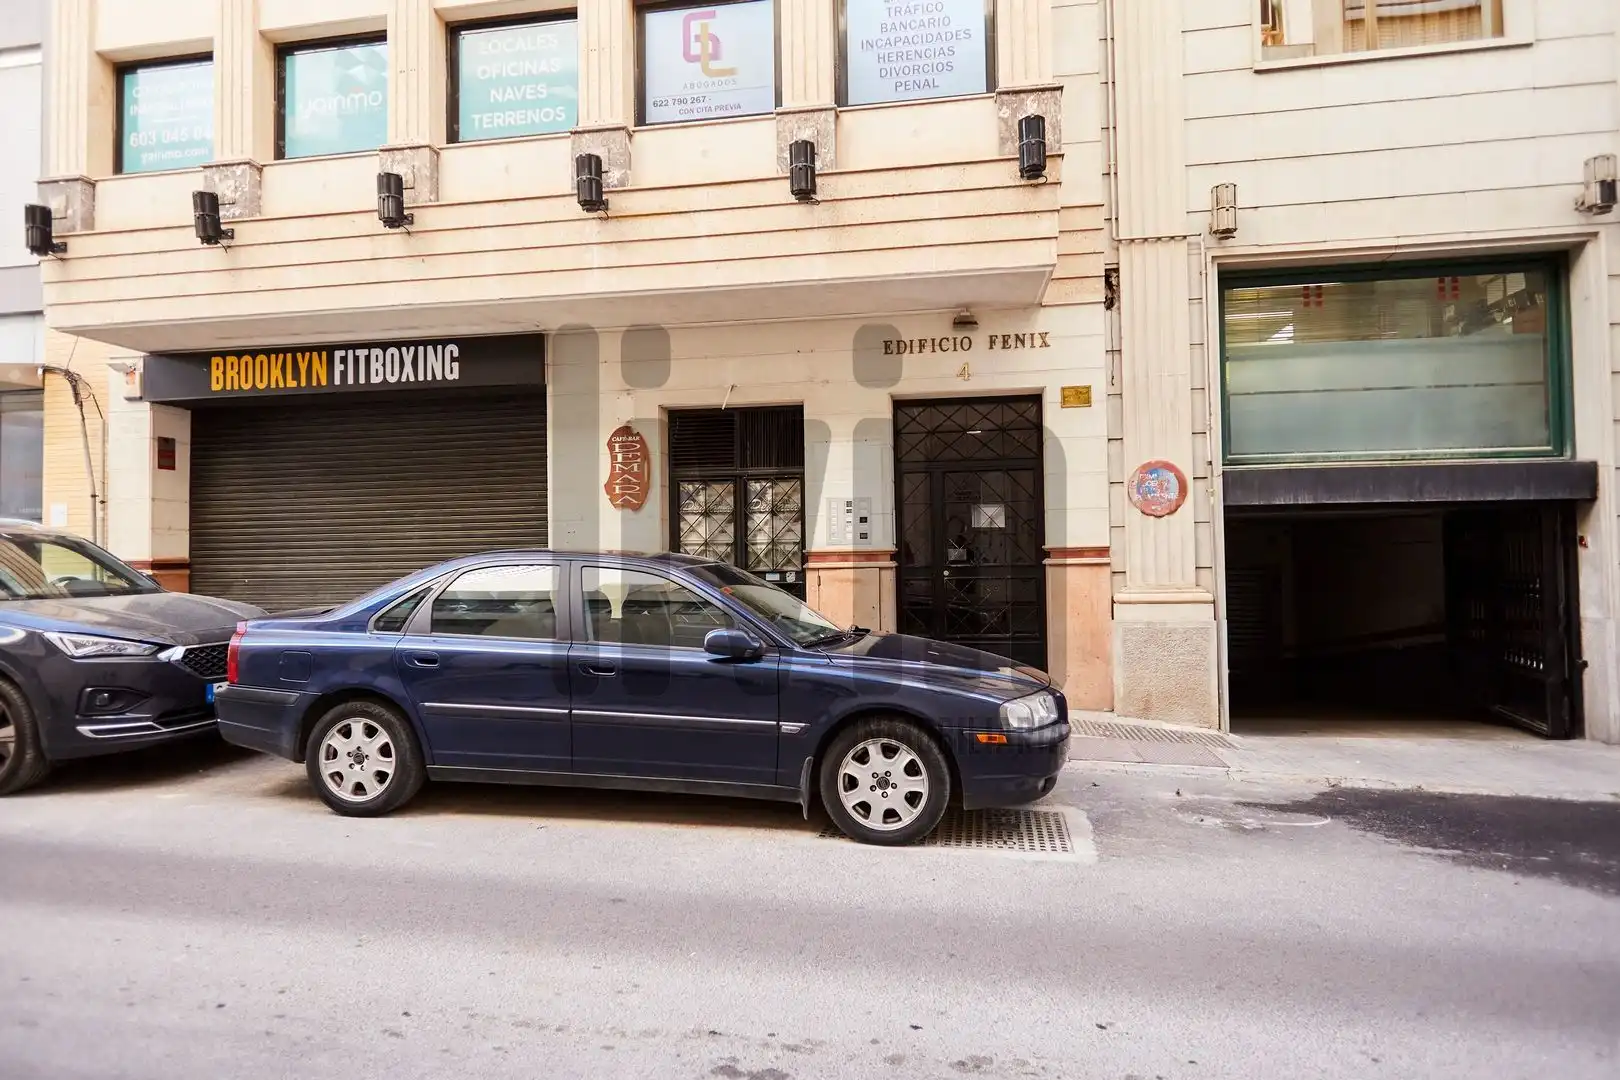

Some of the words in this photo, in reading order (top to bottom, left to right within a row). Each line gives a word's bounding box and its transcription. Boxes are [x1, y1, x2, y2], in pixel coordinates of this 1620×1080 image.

[886, 1, 944, 17] TRÁFICO
[880, 16, 951, 34] BANCARIO
[479, 33, 558, 55] LOCALES
[861, 28, 972, 50] INCAPACIDADES
[877, 45, 955, 64] HERENCIAS
[476, 58, 561, 80] OFICINAS
[879, 61, 954, 78] DIVORCIOS
[489, 84, 548, 103] NAVES
[683, 78, 737, 90] ABOGADOS
[895, 78, 939, 92] PENAL
[652, 98, 669, 108] 622
[671, 96, 688, 106] 790
[690, 95, 707, 105] 267
[678, 106, 694, 115] CON
[696, 104, 713, 114] CITA
[715, 103, 742, 113] PREVIA
[471, 107, 566, 129] TERRENOS
[883, 336, 972, 355] EDIFICIO
[988, 331, 1051, 350] FENIX
[210, 350, 328, 392] BROOKLYN
[334, 343, 460, 386] FITBOXING
[957, 362, 971, 381] 4
